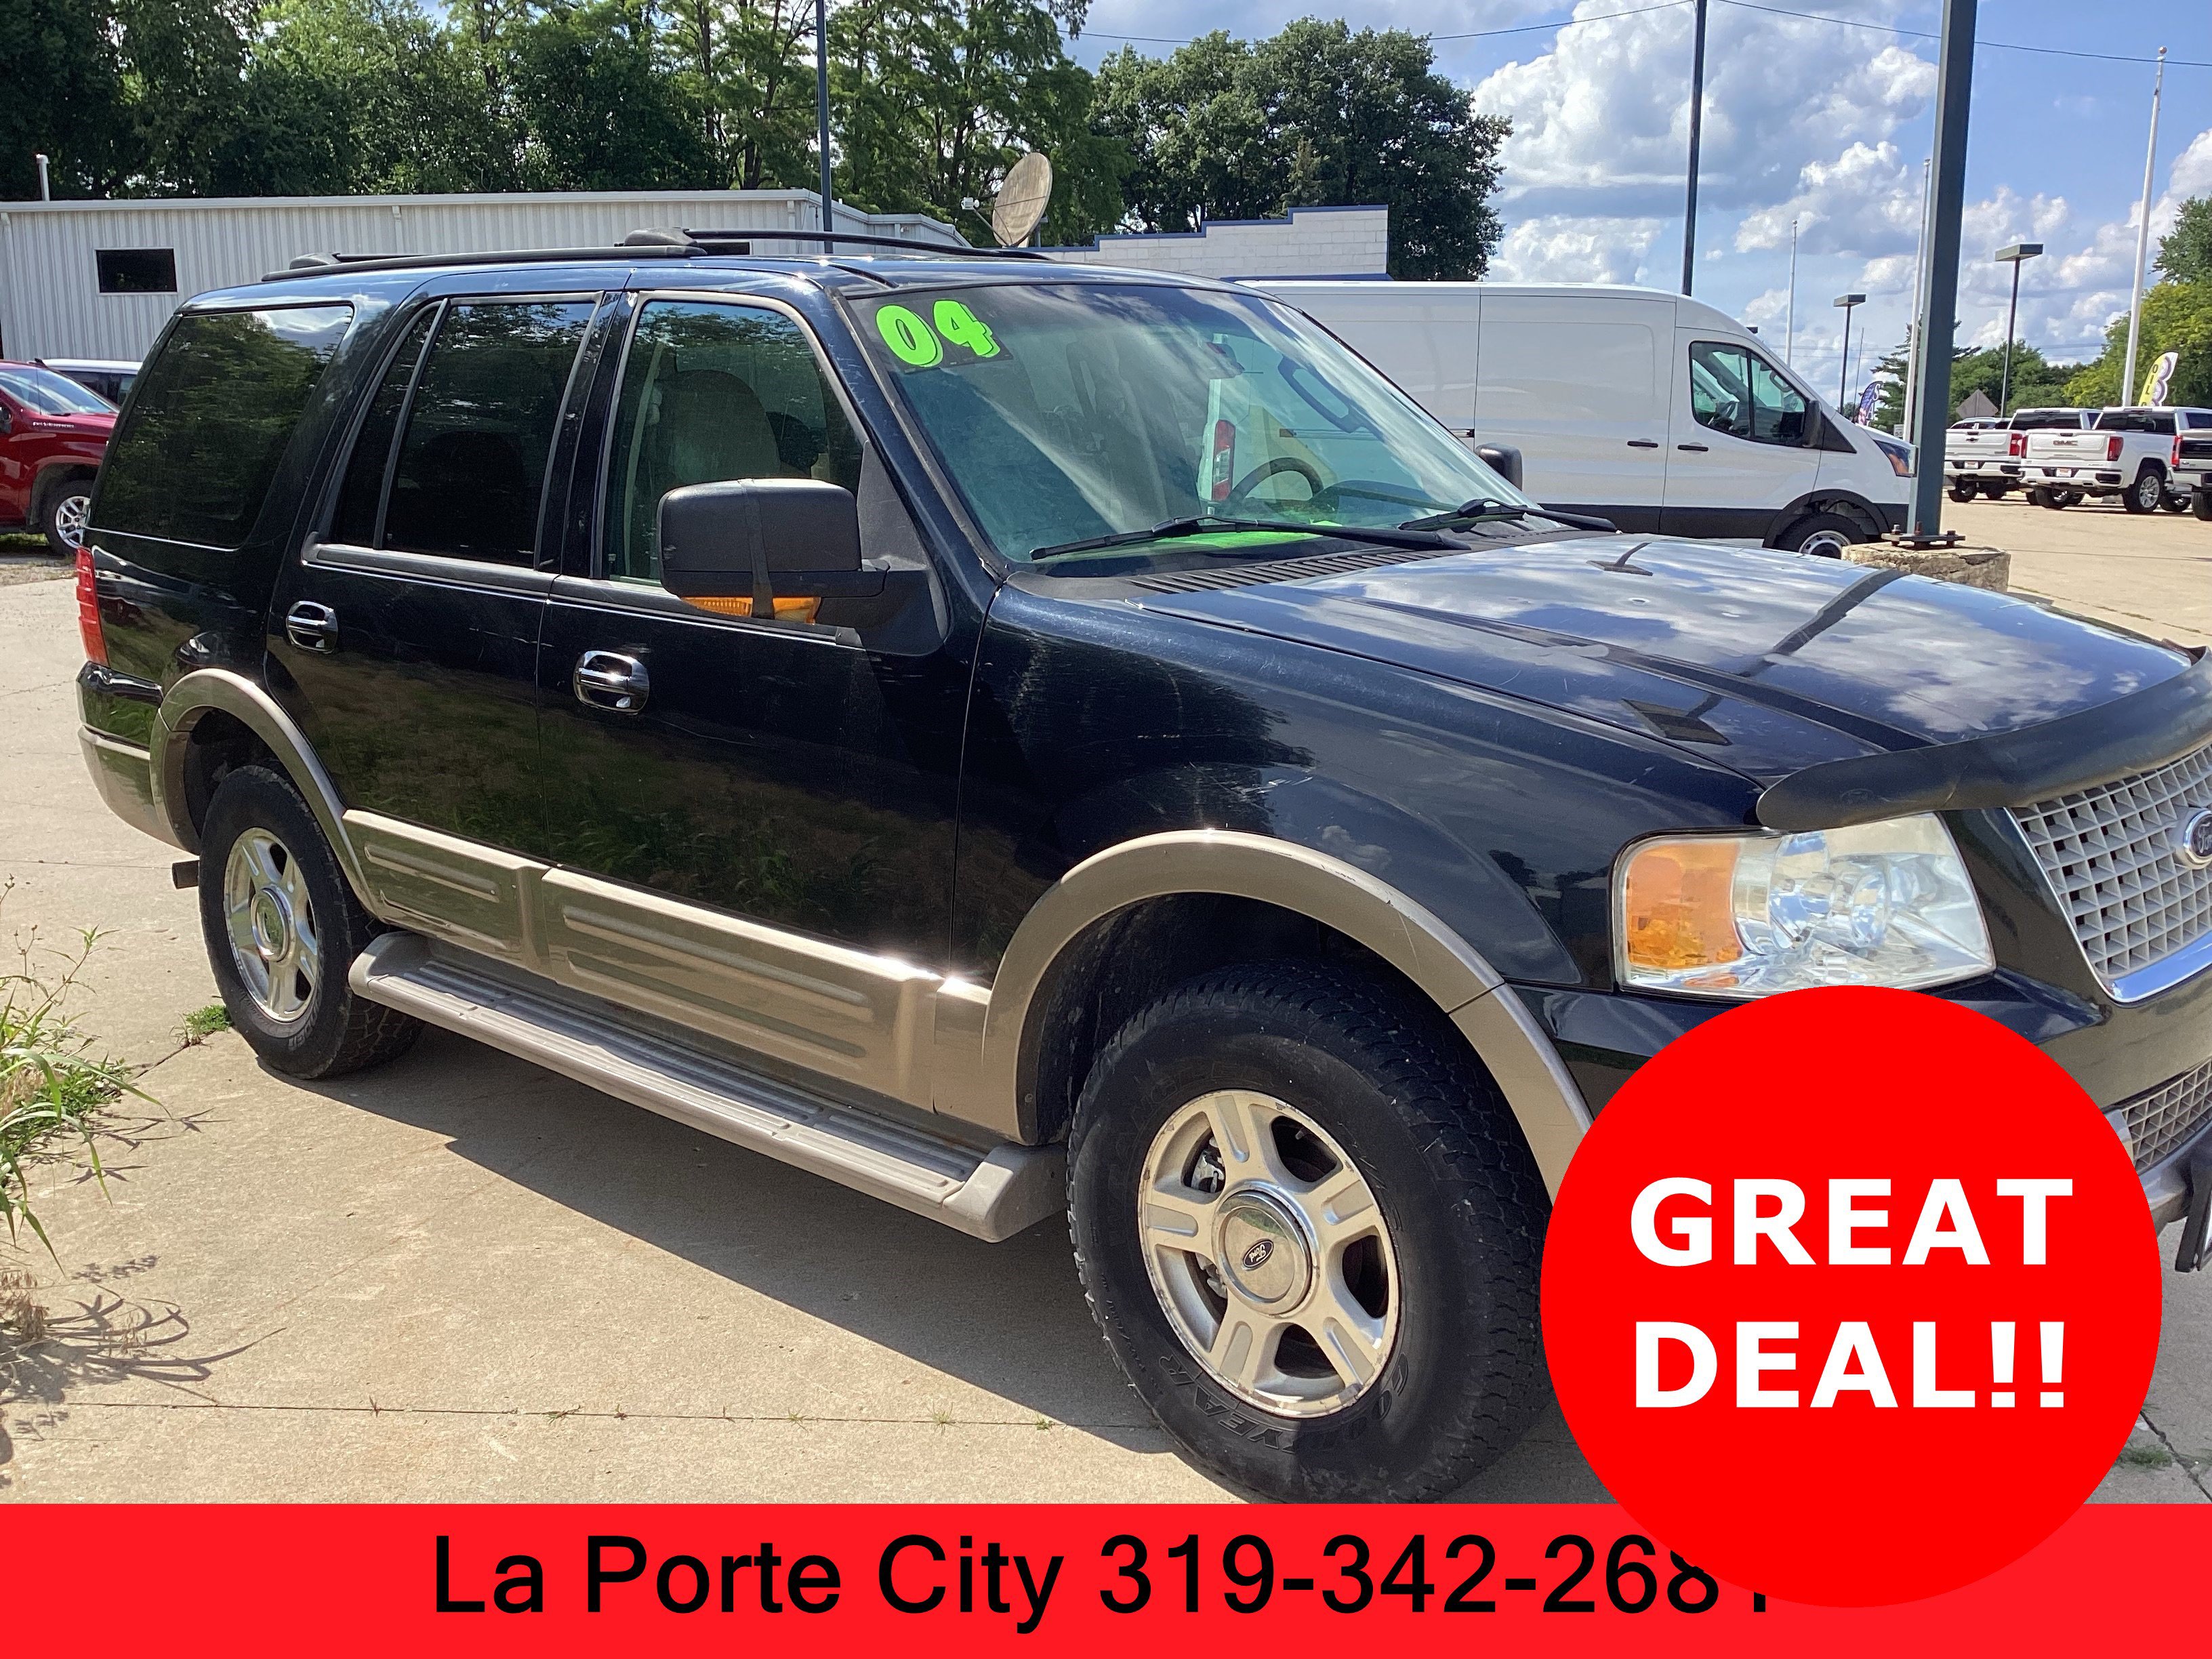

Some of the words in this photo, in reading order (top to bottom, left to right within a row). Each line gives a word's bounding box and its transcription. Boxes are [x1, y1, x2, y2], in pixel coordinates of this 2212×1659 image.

[876, 300, 1000, 367] 04
[2145, 364, 2159, 395] OIL
[1866, 383, 1881, 426] SA
[1248, 1244, 1266, 1263] Ford
